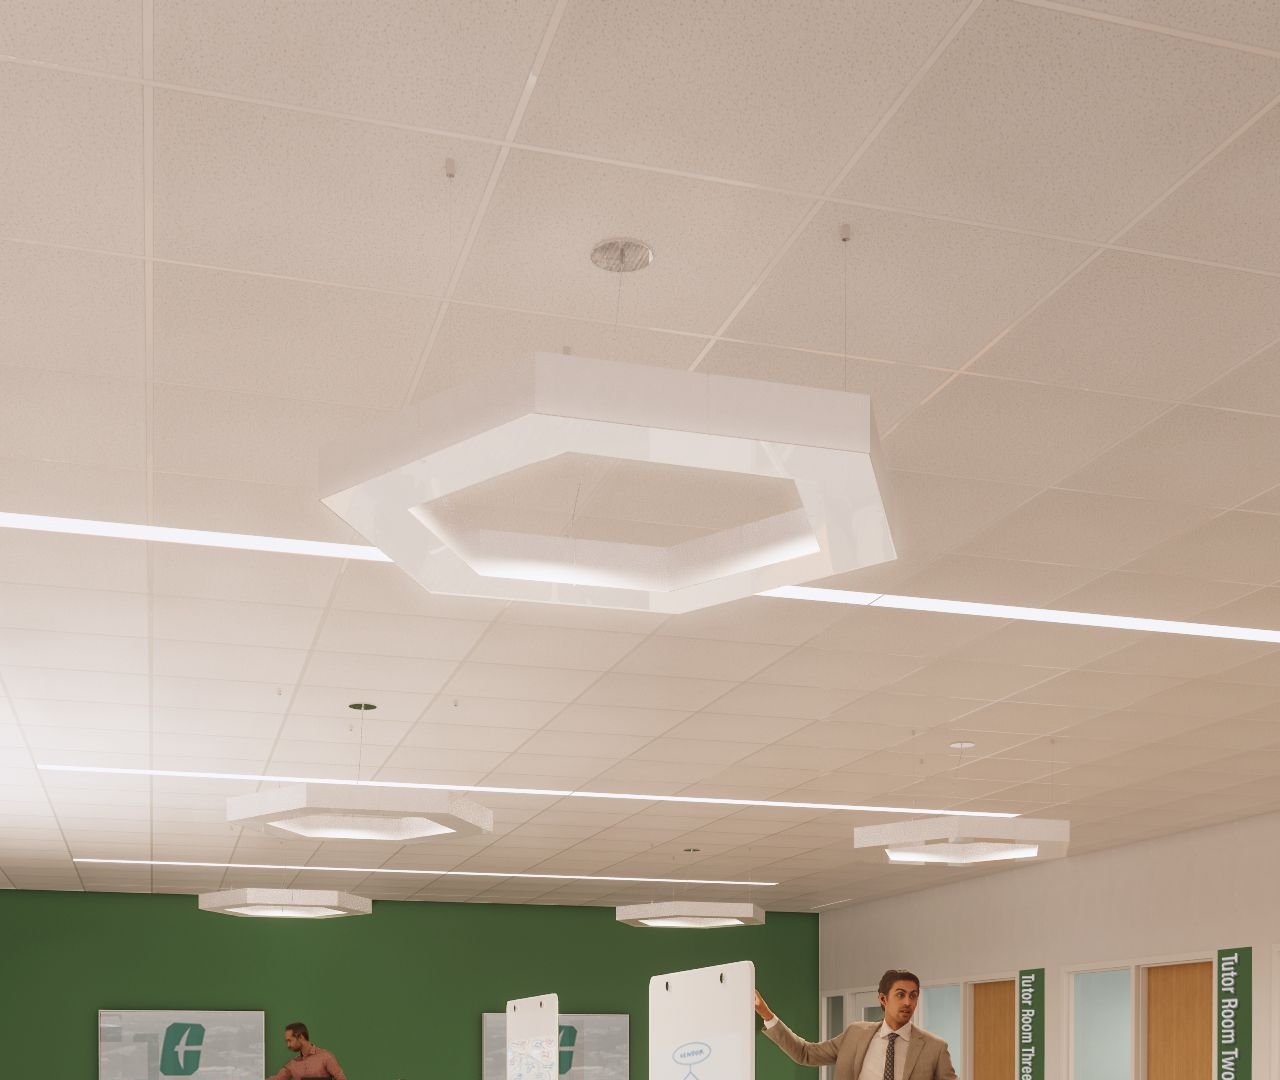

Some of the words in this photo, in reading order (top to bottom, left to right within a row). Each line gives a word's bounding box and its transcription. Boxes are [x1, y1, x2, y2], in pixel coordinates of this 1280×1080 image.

[1021, 973, 1035, 1005] Tutor
[1221, 953, 1238, 993] Tutor
[1021, 1008, 1035, 1043] Room
[1221, 998, 1238, 1044] Room
[1021, 1046, 1035, 1080] Three
